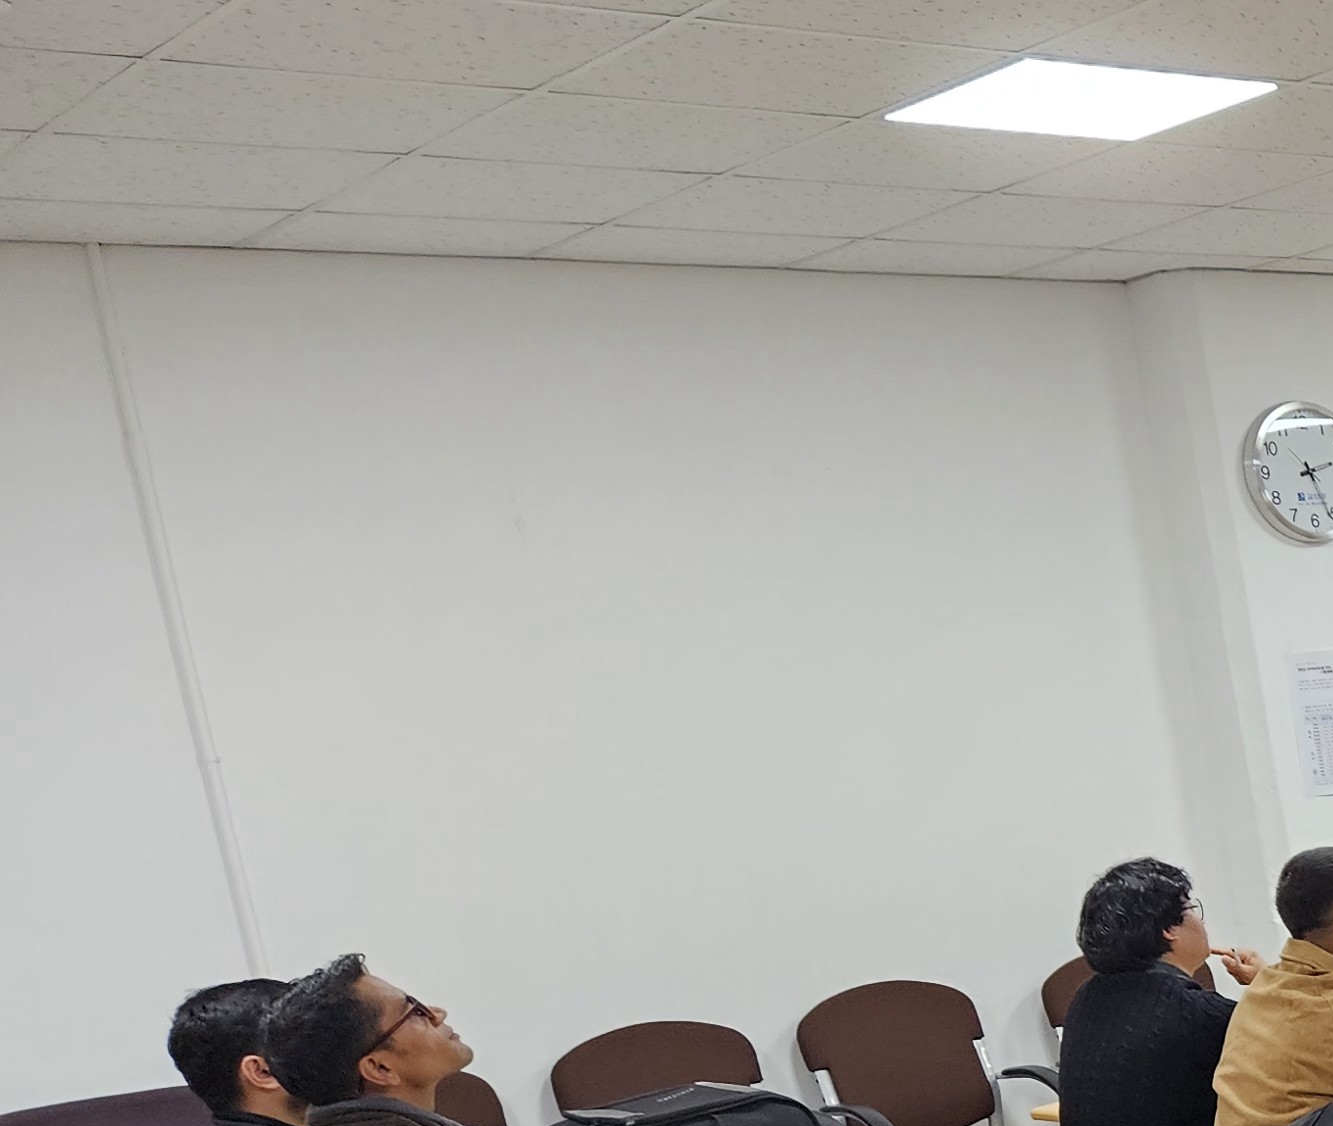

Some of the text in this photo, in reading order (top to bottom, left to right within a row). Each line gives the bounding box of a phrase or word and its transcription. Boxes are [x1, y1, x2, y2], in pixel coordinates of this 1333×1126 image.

[1263, 440, 1278, 456] 10
[1260, 465, 1271, 480] 9
[1271, 490, 1281, 505] 8
[1289, 508, 1298, 522] 7
[1310, 513, 1320, 528] 6
